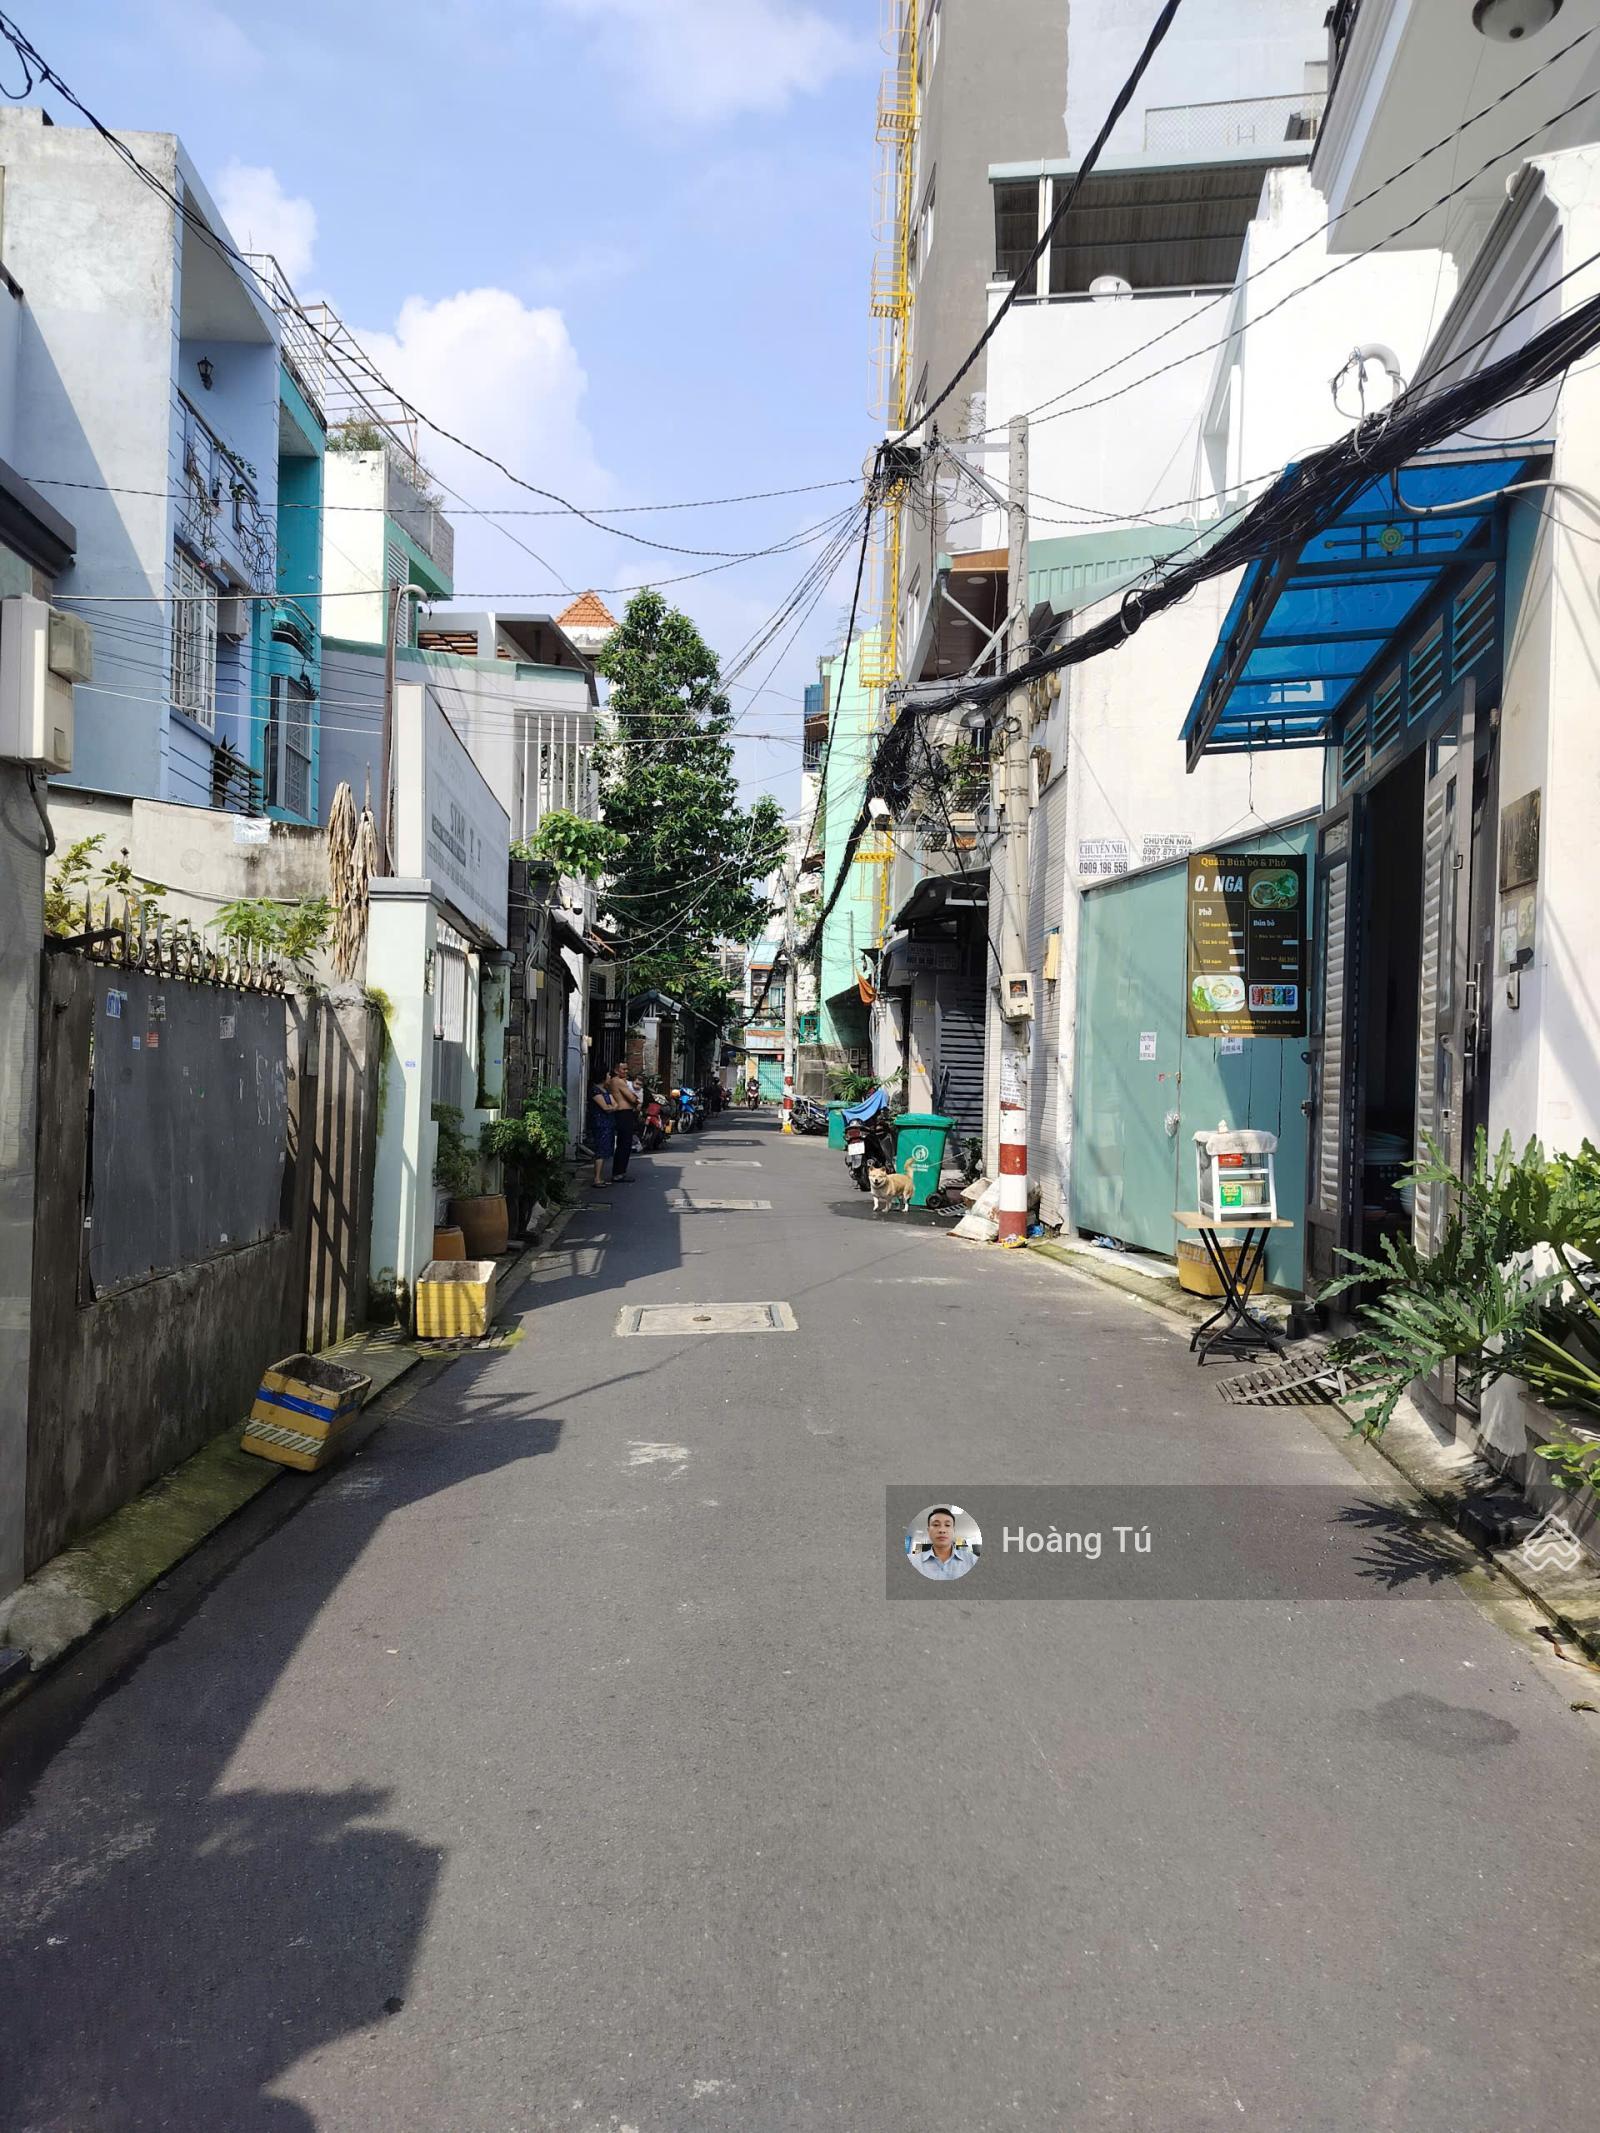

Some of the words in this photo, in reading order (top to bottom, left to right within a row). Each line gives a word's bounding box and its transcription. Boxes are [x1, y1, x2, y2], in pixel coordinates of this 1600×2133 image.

[1080, 862, 1128, 874] 0909.196.559
[1201, 857, 1225, 867] Quán
[1227, 858, 1245, 866] Bún
[1247, 858, 1258, 866] bò
[1269, 858, 1286, 867] Phở
[1213, 875, 1243, 892] NGA
